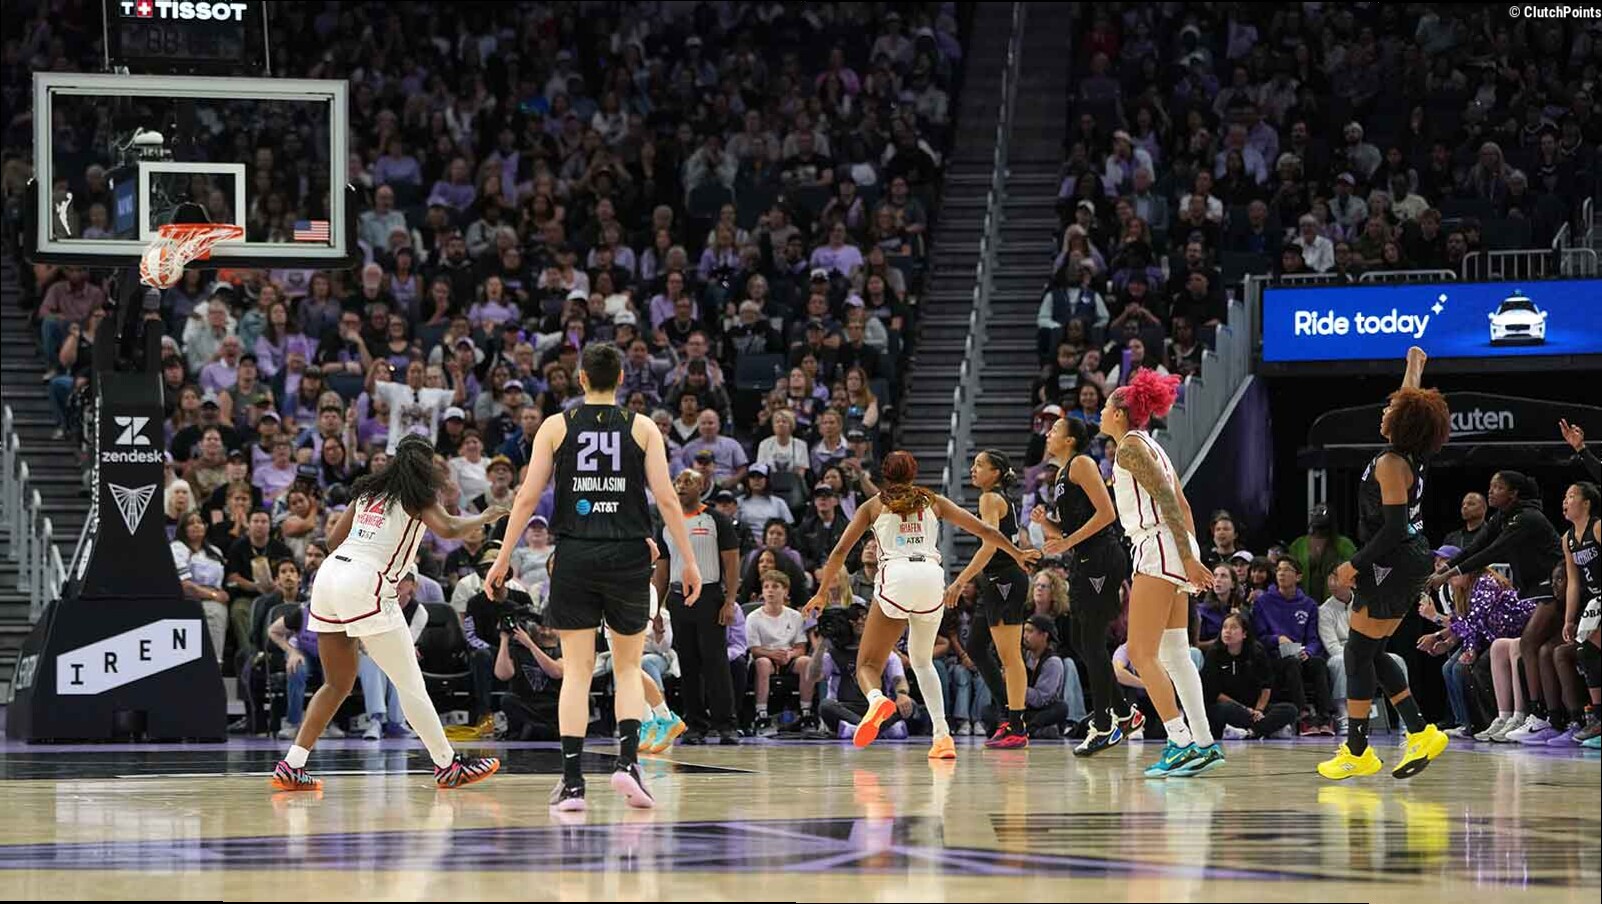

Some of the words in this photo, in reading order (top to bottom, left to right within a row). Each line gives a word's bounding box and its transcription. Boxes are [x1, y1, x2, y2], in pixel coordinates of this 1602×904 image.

[155, 1, 248, 21] TISSOT
[1294, 309, 1350, 335] Ride
[1354, 308, 1430, 339] today
[1450, 407, 1515, 431] kuten
[101, 449, 164, 463] zendesk
[576, 431, 621, 472] 24
[572, 476, 626, 492] ZANDALASINI
[592, 501, 620, 513] AT&T
[906, 536, 925, 544] AT&T
[70, 628, 187, 685] IREN
